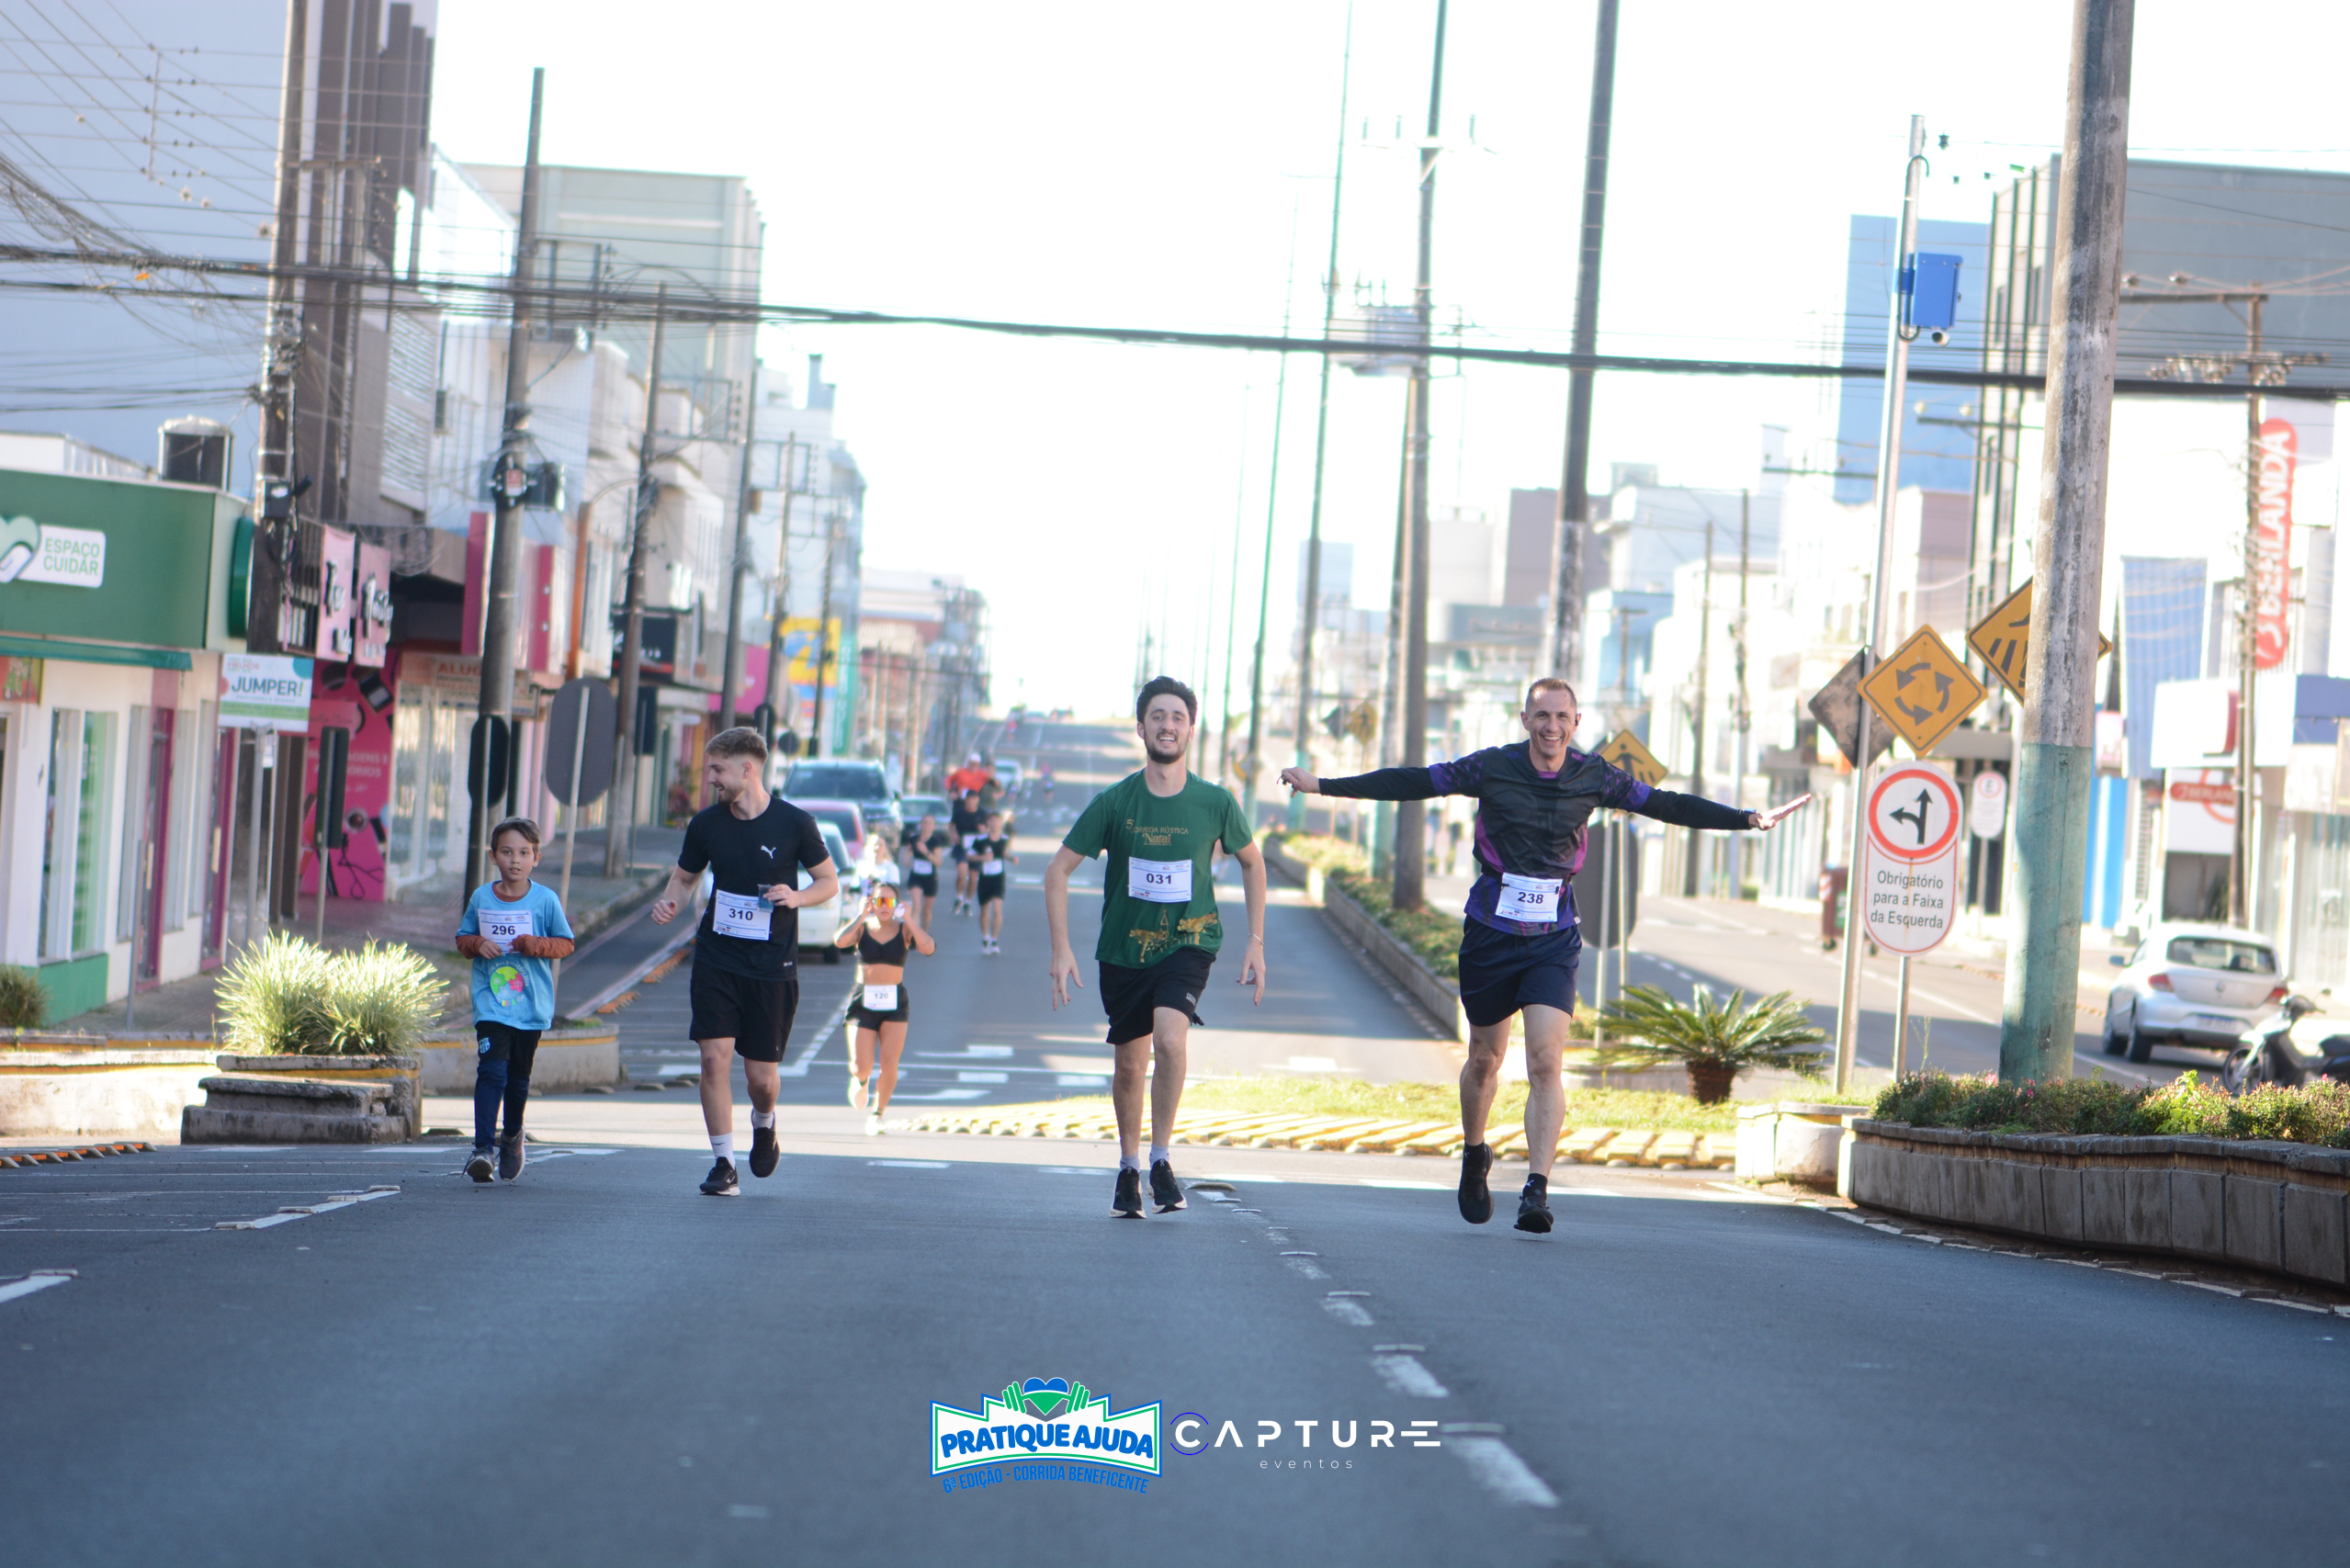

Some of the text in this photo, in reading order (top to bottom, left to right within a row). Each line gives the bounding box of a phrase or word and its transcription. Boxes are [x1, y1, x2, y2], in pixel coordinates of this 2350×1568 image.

[45, 537, 100, 558] ESPAÇO
[43, 555, 98, 576] CUIDAR
[232, 676, 304, 697] JUMPER!
[1142, 832, 1172, 843] Natal
[1160, 826, 1189, 834] RÚSTICA
[1146, 873, 1172, 885] 031
[1877, 870, 1944, 889] Obrigatório
[1518, 891, 1544, 904] 238
[1872, 892, 1944, 909] para a Faixa
[729, 908, 754, 921] 310
[1870, 909, 1943, 929] da Esquerda
[491, 924, 516, 936] 296
